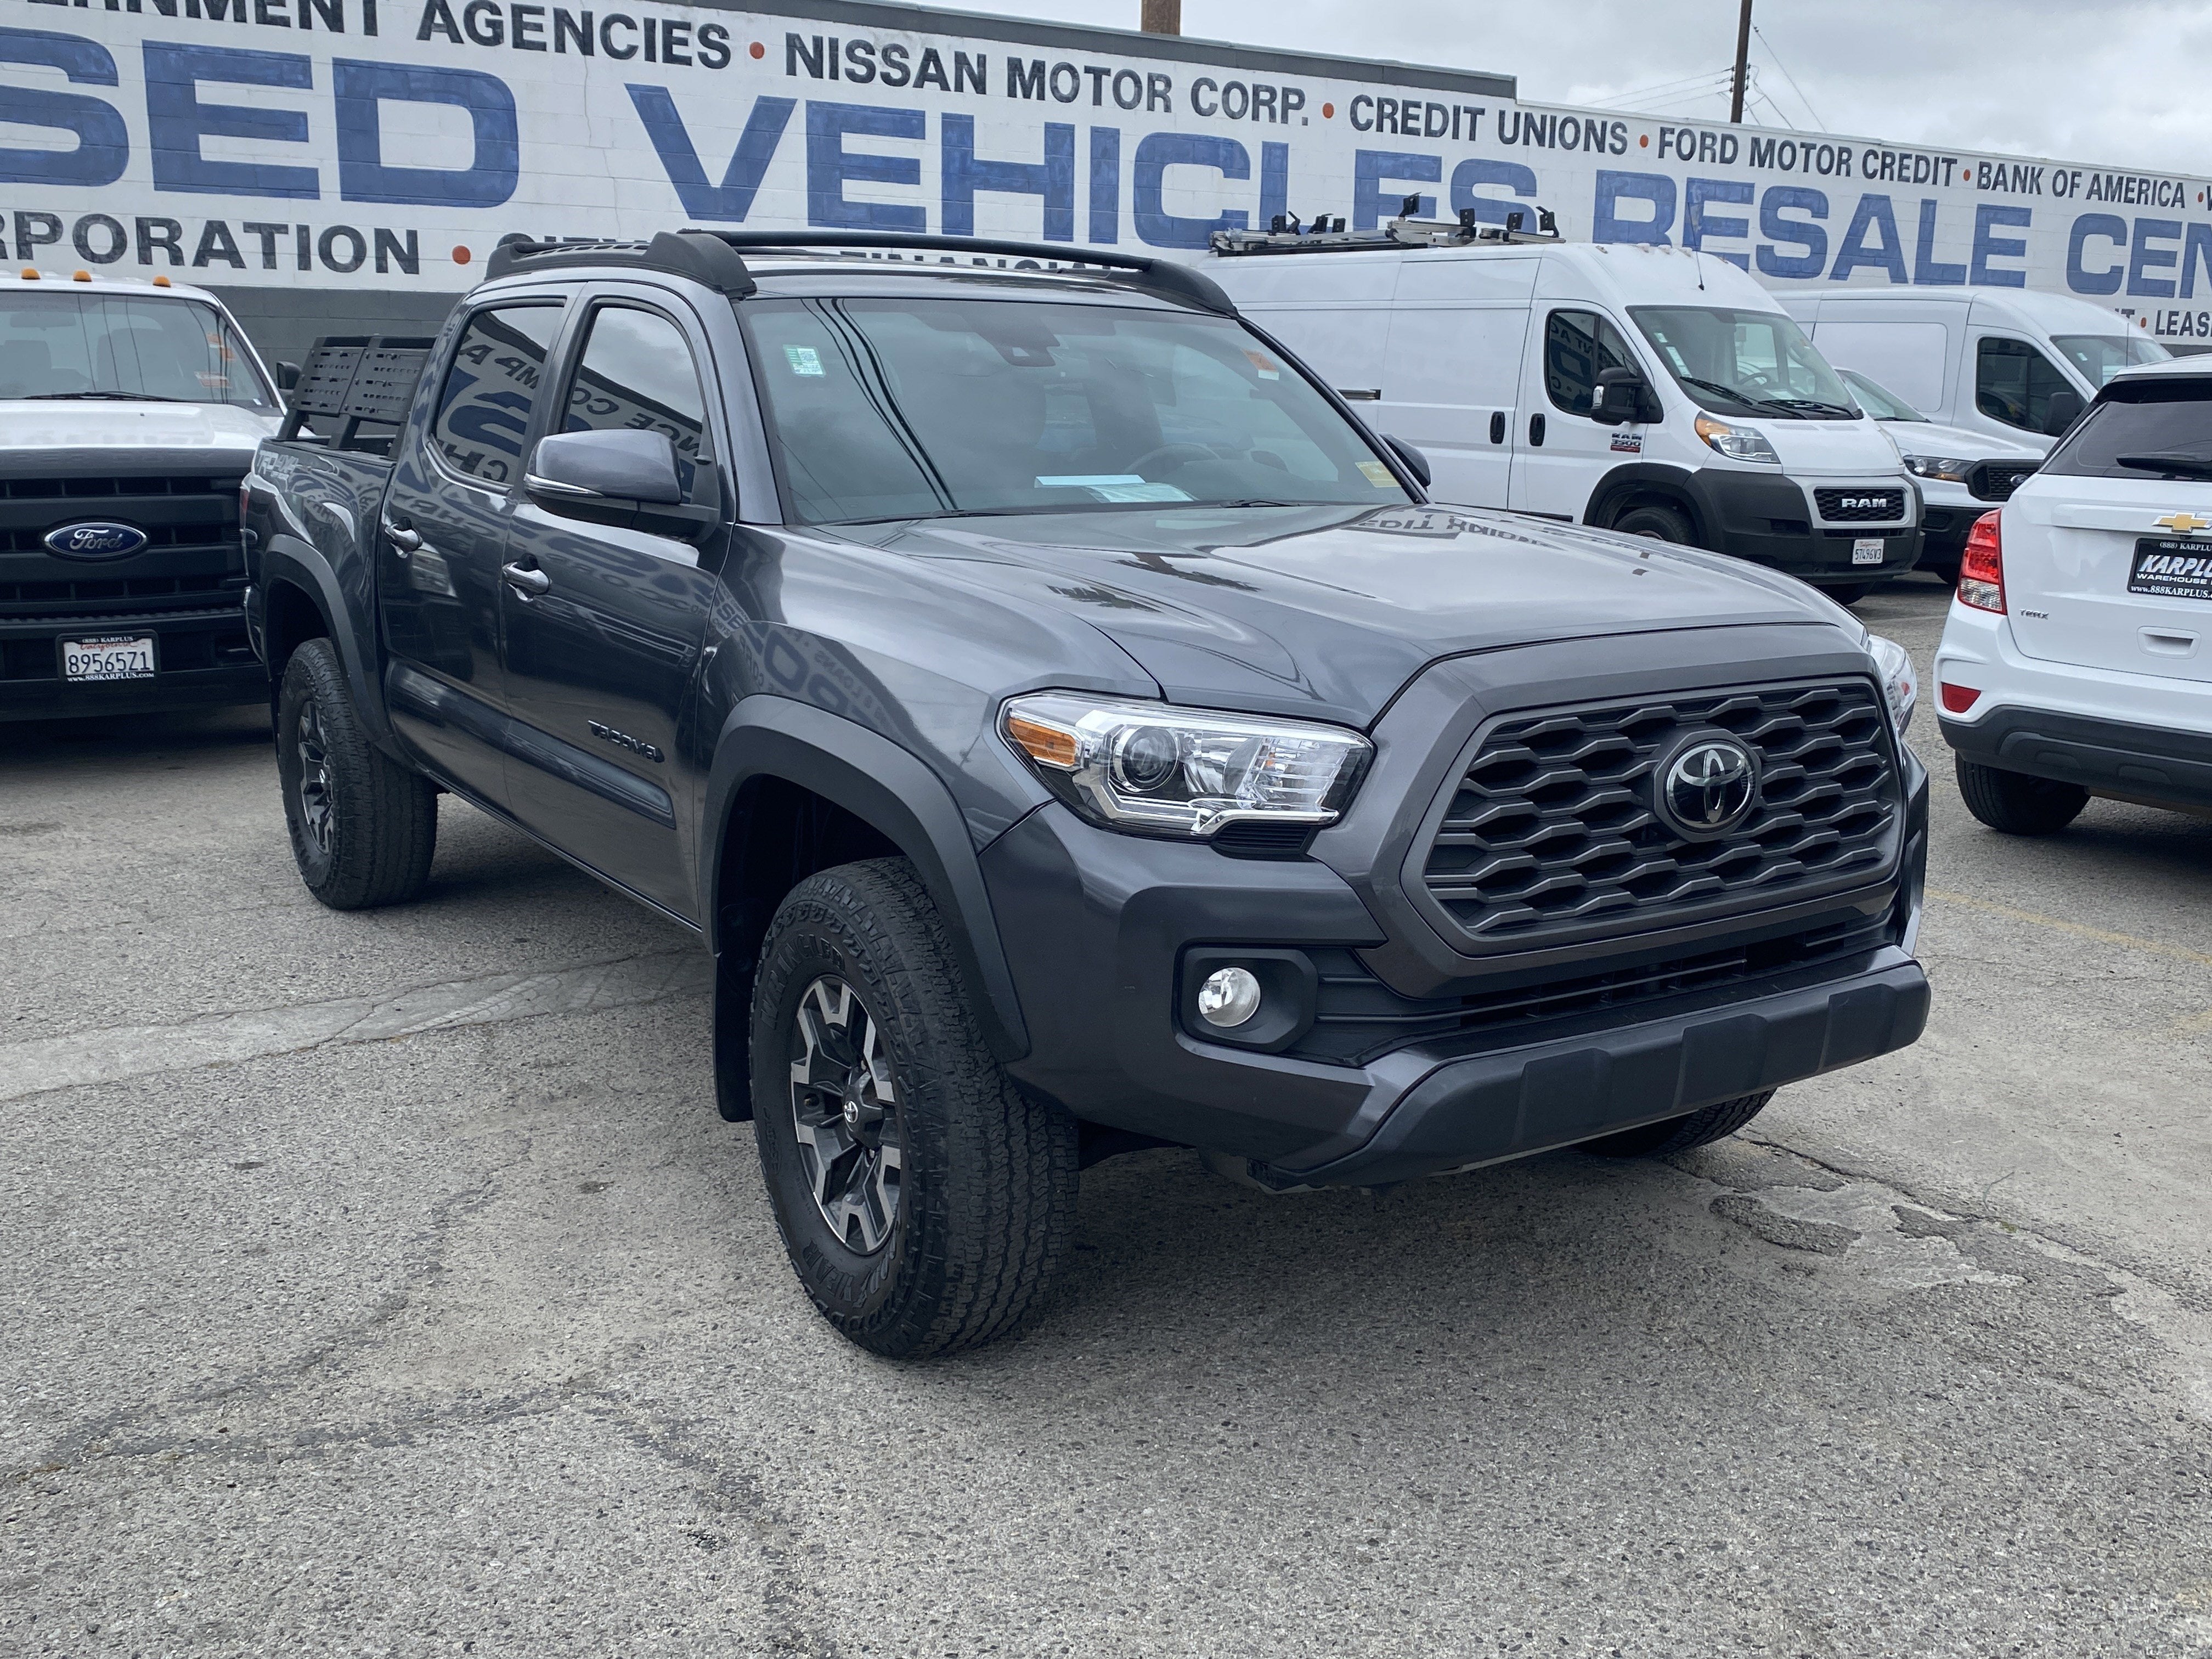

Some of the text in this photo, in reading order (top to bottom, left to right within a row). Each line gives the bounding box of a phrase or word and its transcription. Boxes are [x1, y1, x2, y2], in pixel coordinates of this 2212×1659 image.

[416, 0, 730, 69] AGENCIES
[786, 32, 1308, 126] NISSAN MOTOR CORP.
[1350, 94, 1628, 156] CREDIT UNIONS
[0, 26, 520, 208] SED
[624, 82, 1537, 250] VEHICLES
[1592, 169, 2032, 289] RESALE
[1658, 127, 1958, 187] FORD MOTOR CREDIT
[1977, 161, 2046, 195] BANK
[2052, 168, 2083, 198] OF
[2086, 173, 2186, 209] AMERICA
[0, 210, 420, 275] PORATION
[2154, 309, 2212, 337] LEAS
[1842, 498, 1887, 508] RAM
[69, 528, 123, 550] Ford
[2136, 573, 2208, 585] WAREHOUSE
[2019, 608, 2049, 620] TRAX
[69, 651, 151, 674] 89565Z1
[588, 719, 665, 763] TACOMA
